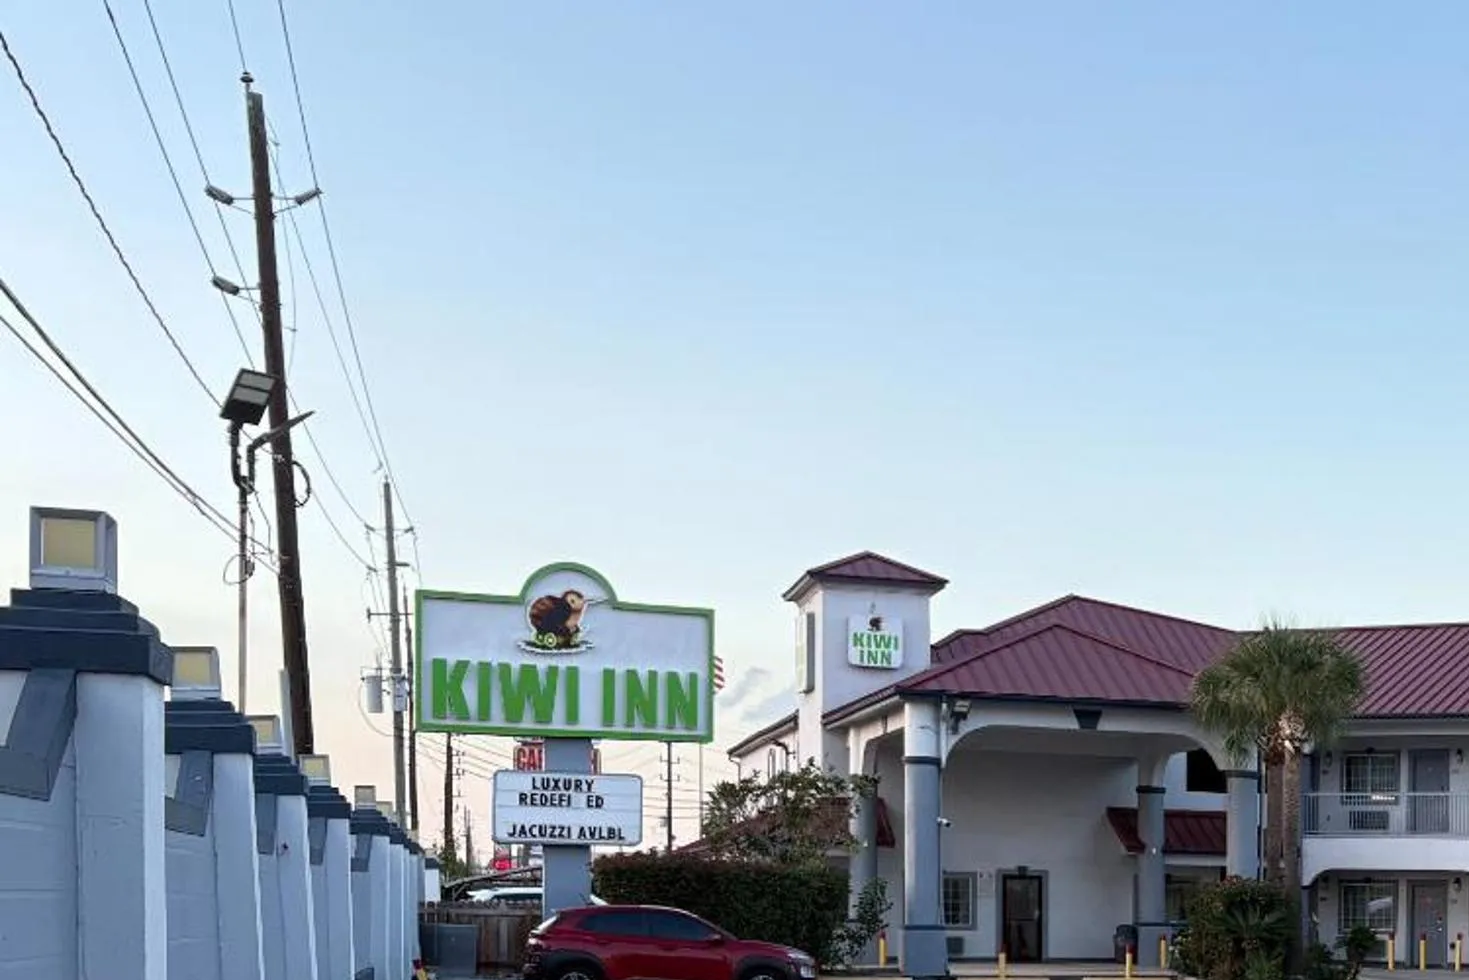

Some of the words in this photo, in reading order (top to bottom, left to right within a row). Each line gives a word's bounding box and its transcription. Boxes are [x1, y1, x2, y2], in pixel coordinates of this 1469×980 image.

[852, 632, 898, 651] KIWI
[859, 650, 892, 665] INN
[431, 657, 579, 725] KIWI
[602, 667, 698, 730] INN
[531, 776, 595, 792] LUXURY
[507, 823, 571, 840] JACUZZI
[577, 825, 626, 841] AVLBL
